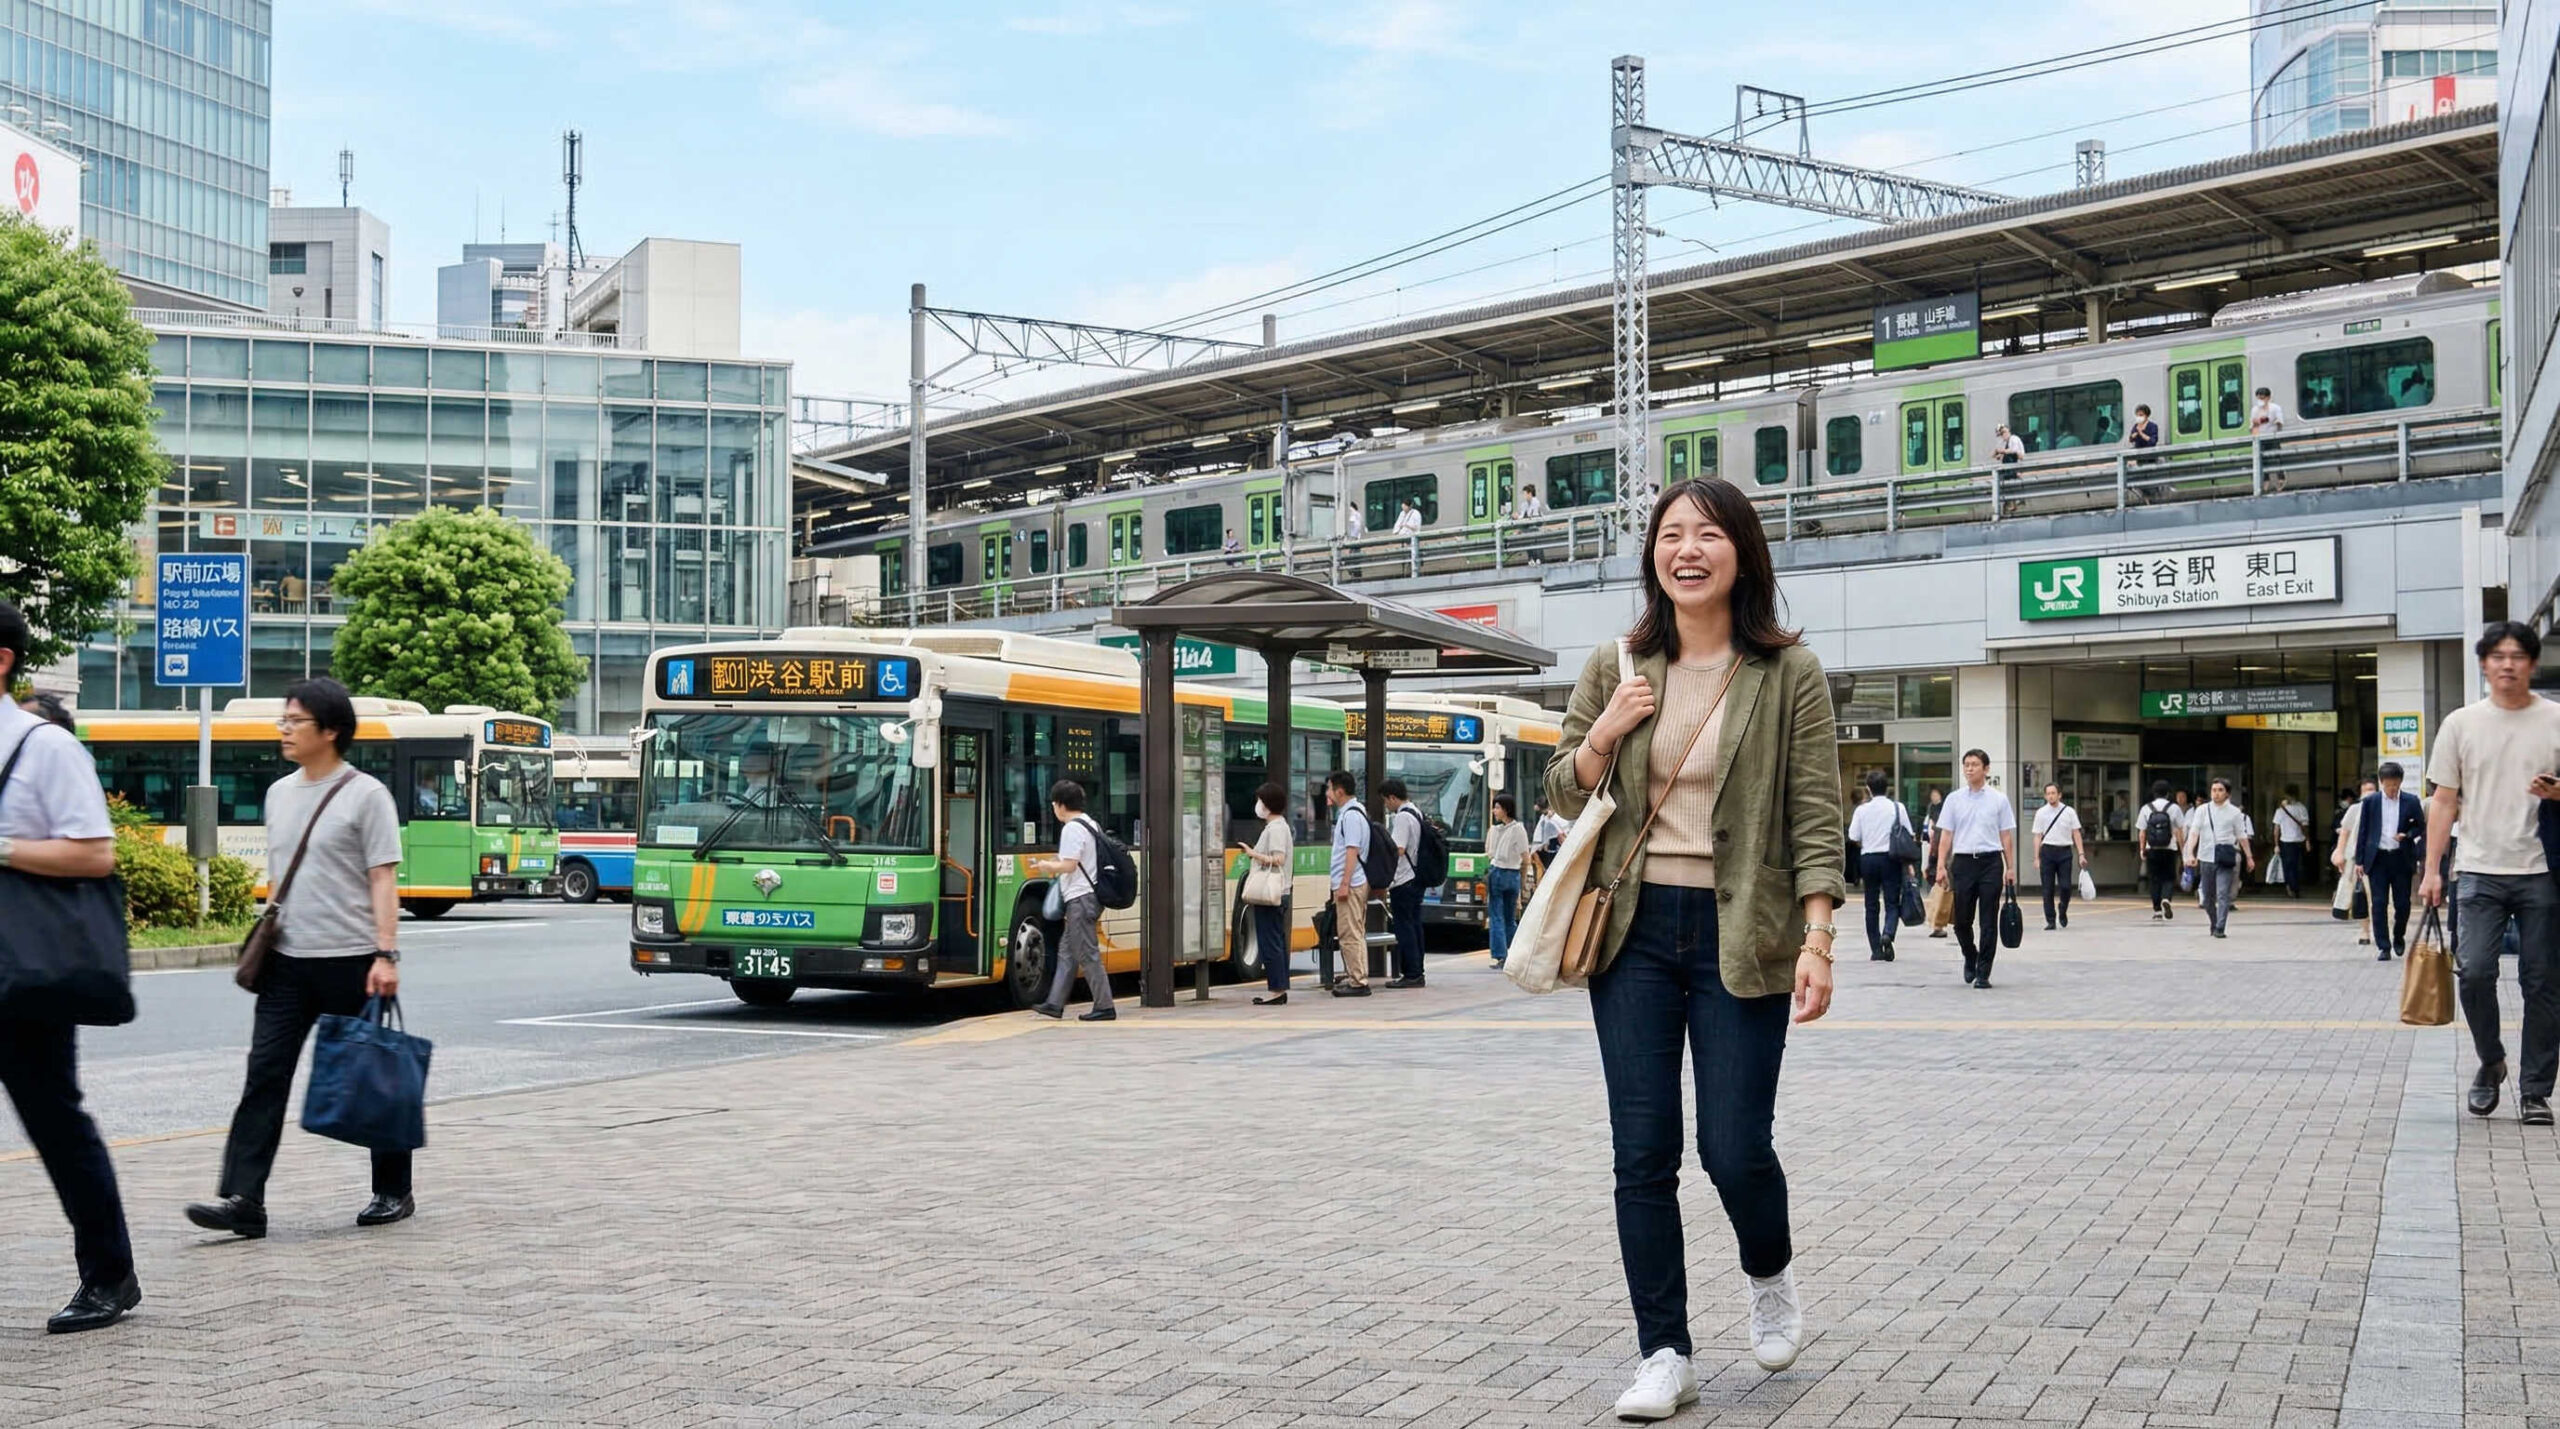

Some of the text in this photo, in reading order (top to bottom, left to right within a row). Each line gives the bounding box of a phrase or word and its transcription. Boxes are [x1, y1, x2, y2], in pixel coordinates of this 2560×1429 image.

[1881, 316, 1890, 340] 1
[163, 562, 241, 583] 駅前広場
[2034, 566, 2084, 601] JR
[2117, 551, 2297, 590] 渋谷駅 東口
[2117, 579, 2314, 608] Shibuya Station East Exit
[163, 617, 240, 639] 路線バス
[750, 659, 866, 689] 渋谷駅前
[2160, 694, 2183, 710] JR
